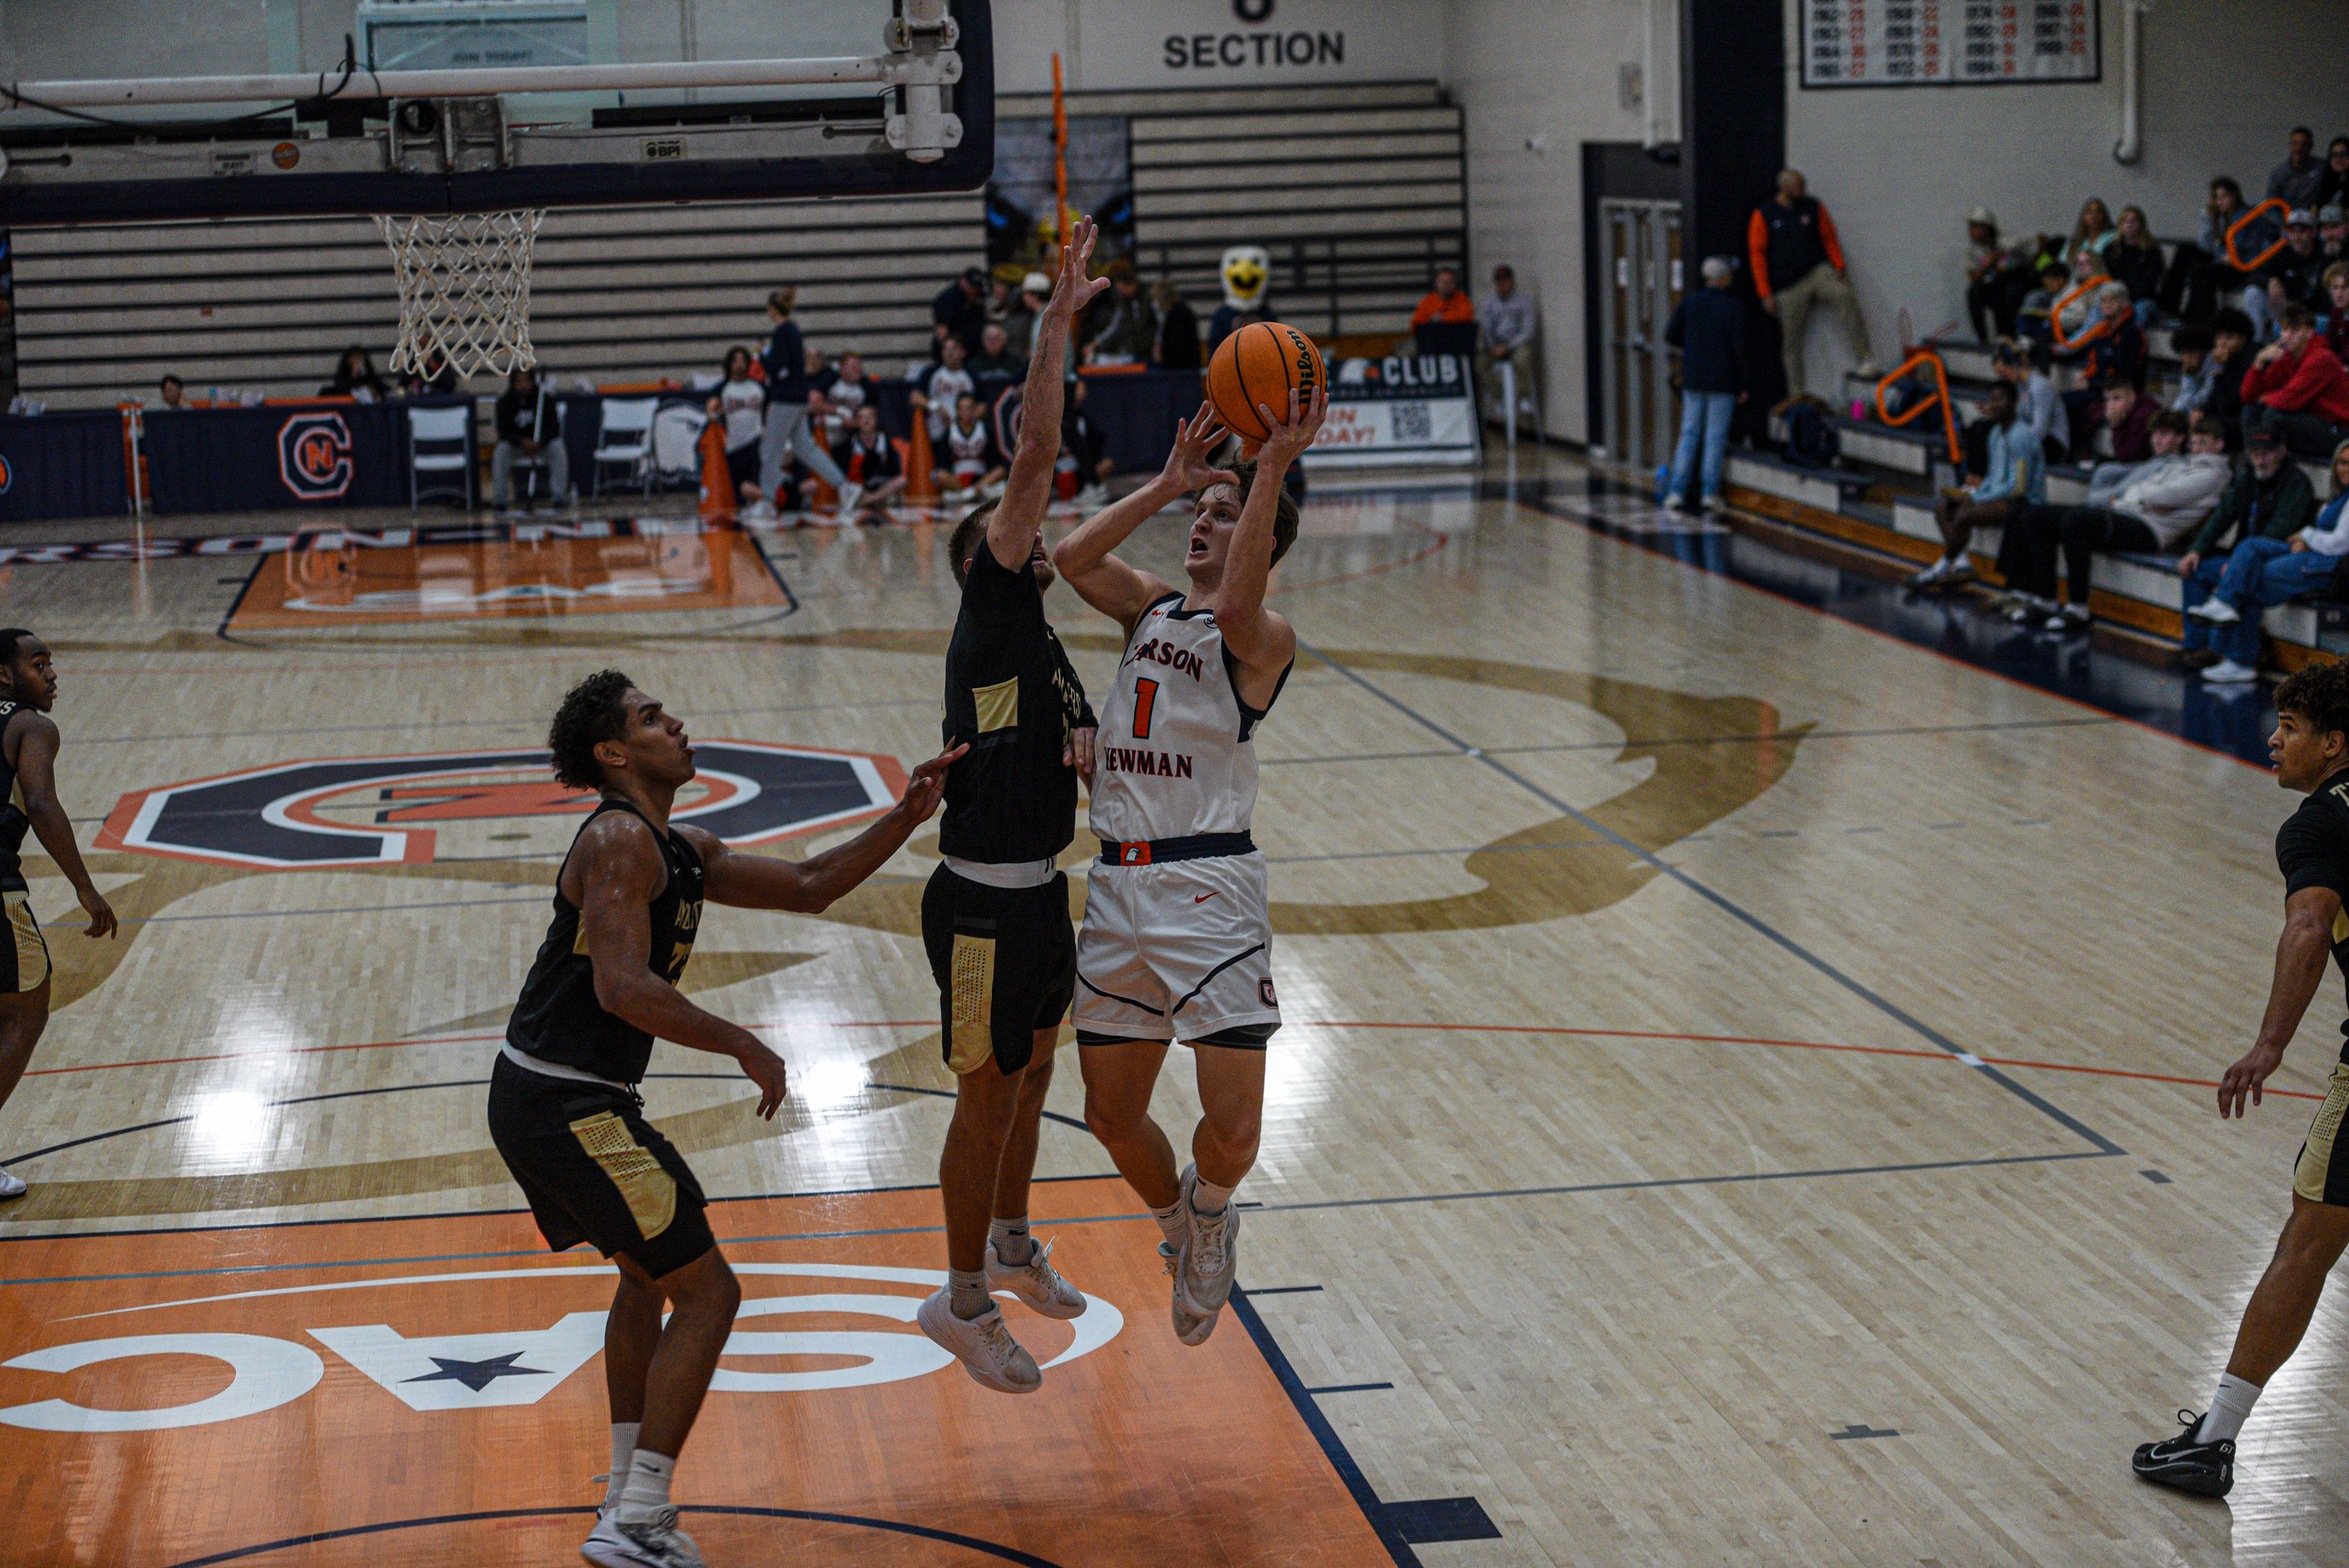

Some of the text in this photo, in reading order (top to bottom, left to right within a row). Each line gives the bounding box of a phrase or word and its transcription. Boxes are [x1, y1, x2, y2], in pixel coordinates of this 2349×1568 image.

[1164, 31, 1345, 68] SECTION
[1382, 354, 1459, 386] CLUB
[1327, 407, 1358, 424] IN
[1132, 676, 1160, 740] 1
